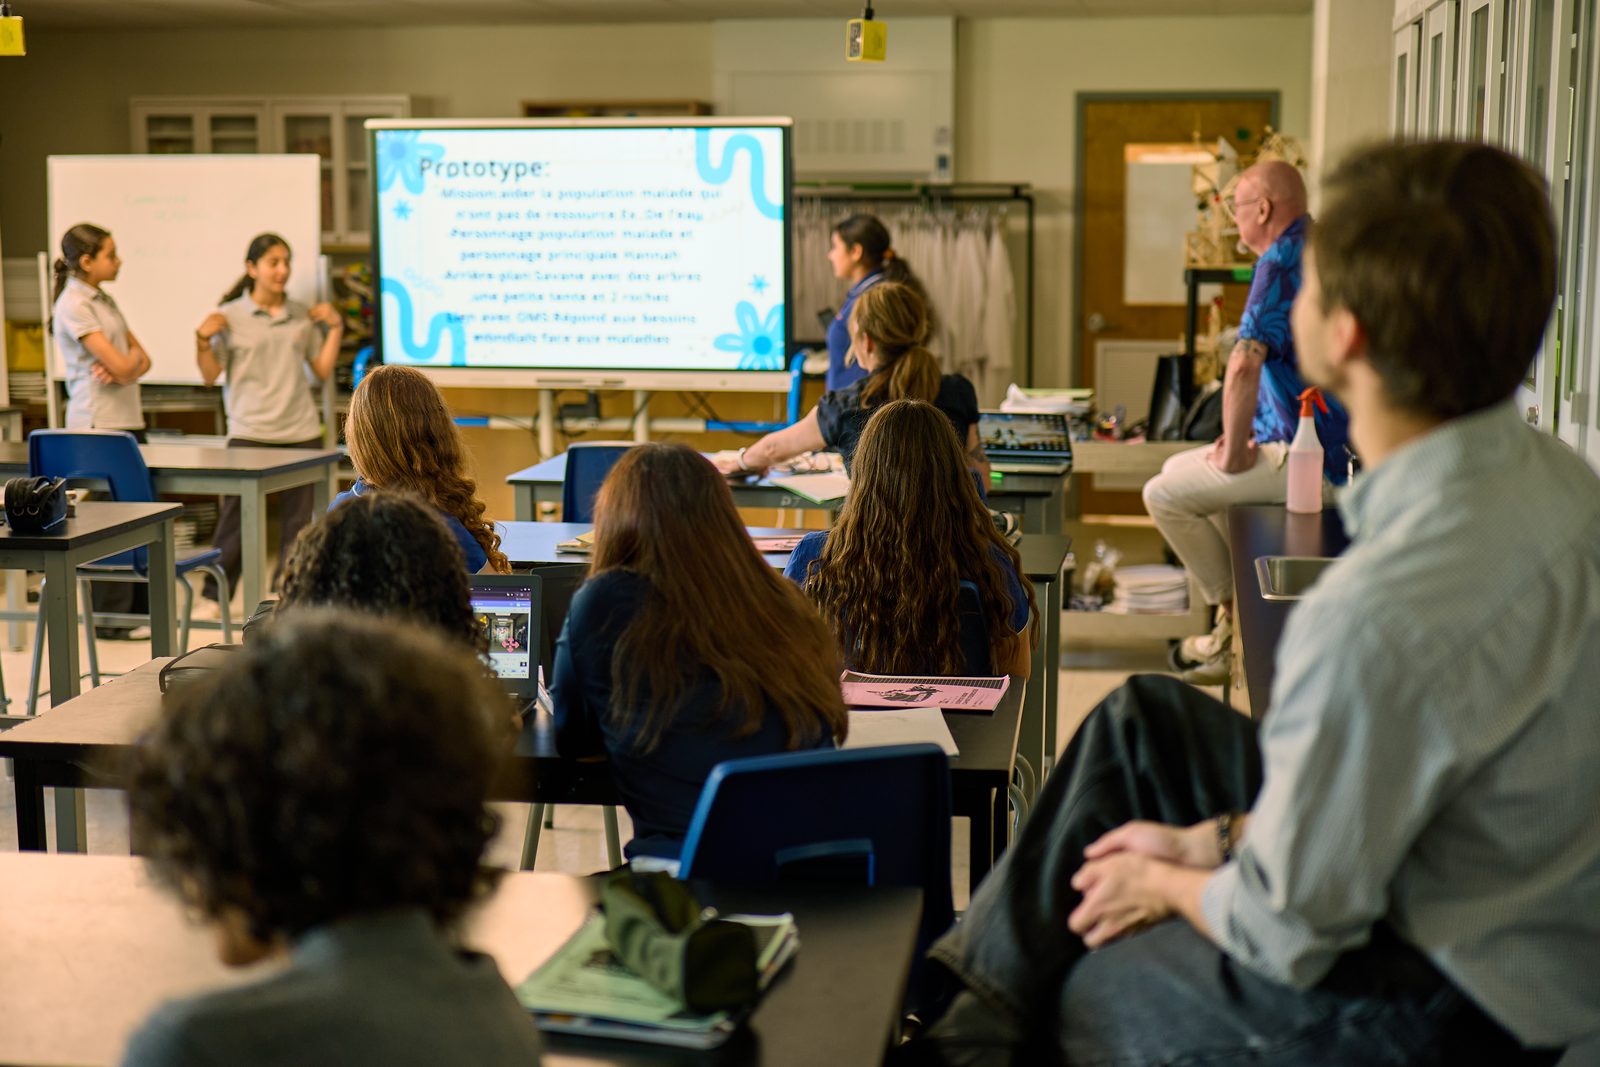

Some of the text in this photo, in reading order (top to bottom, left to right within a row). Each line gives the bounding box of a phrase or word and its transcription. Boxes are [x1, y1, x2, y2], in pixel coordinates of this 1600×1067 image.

[420, 158, 550, 182] Prototype:
[558, 188, 635, 201] population
[642, 188, 693, 198] malade
[538, 228, 615, 240] population
[623, 228, 673, 239] malade
